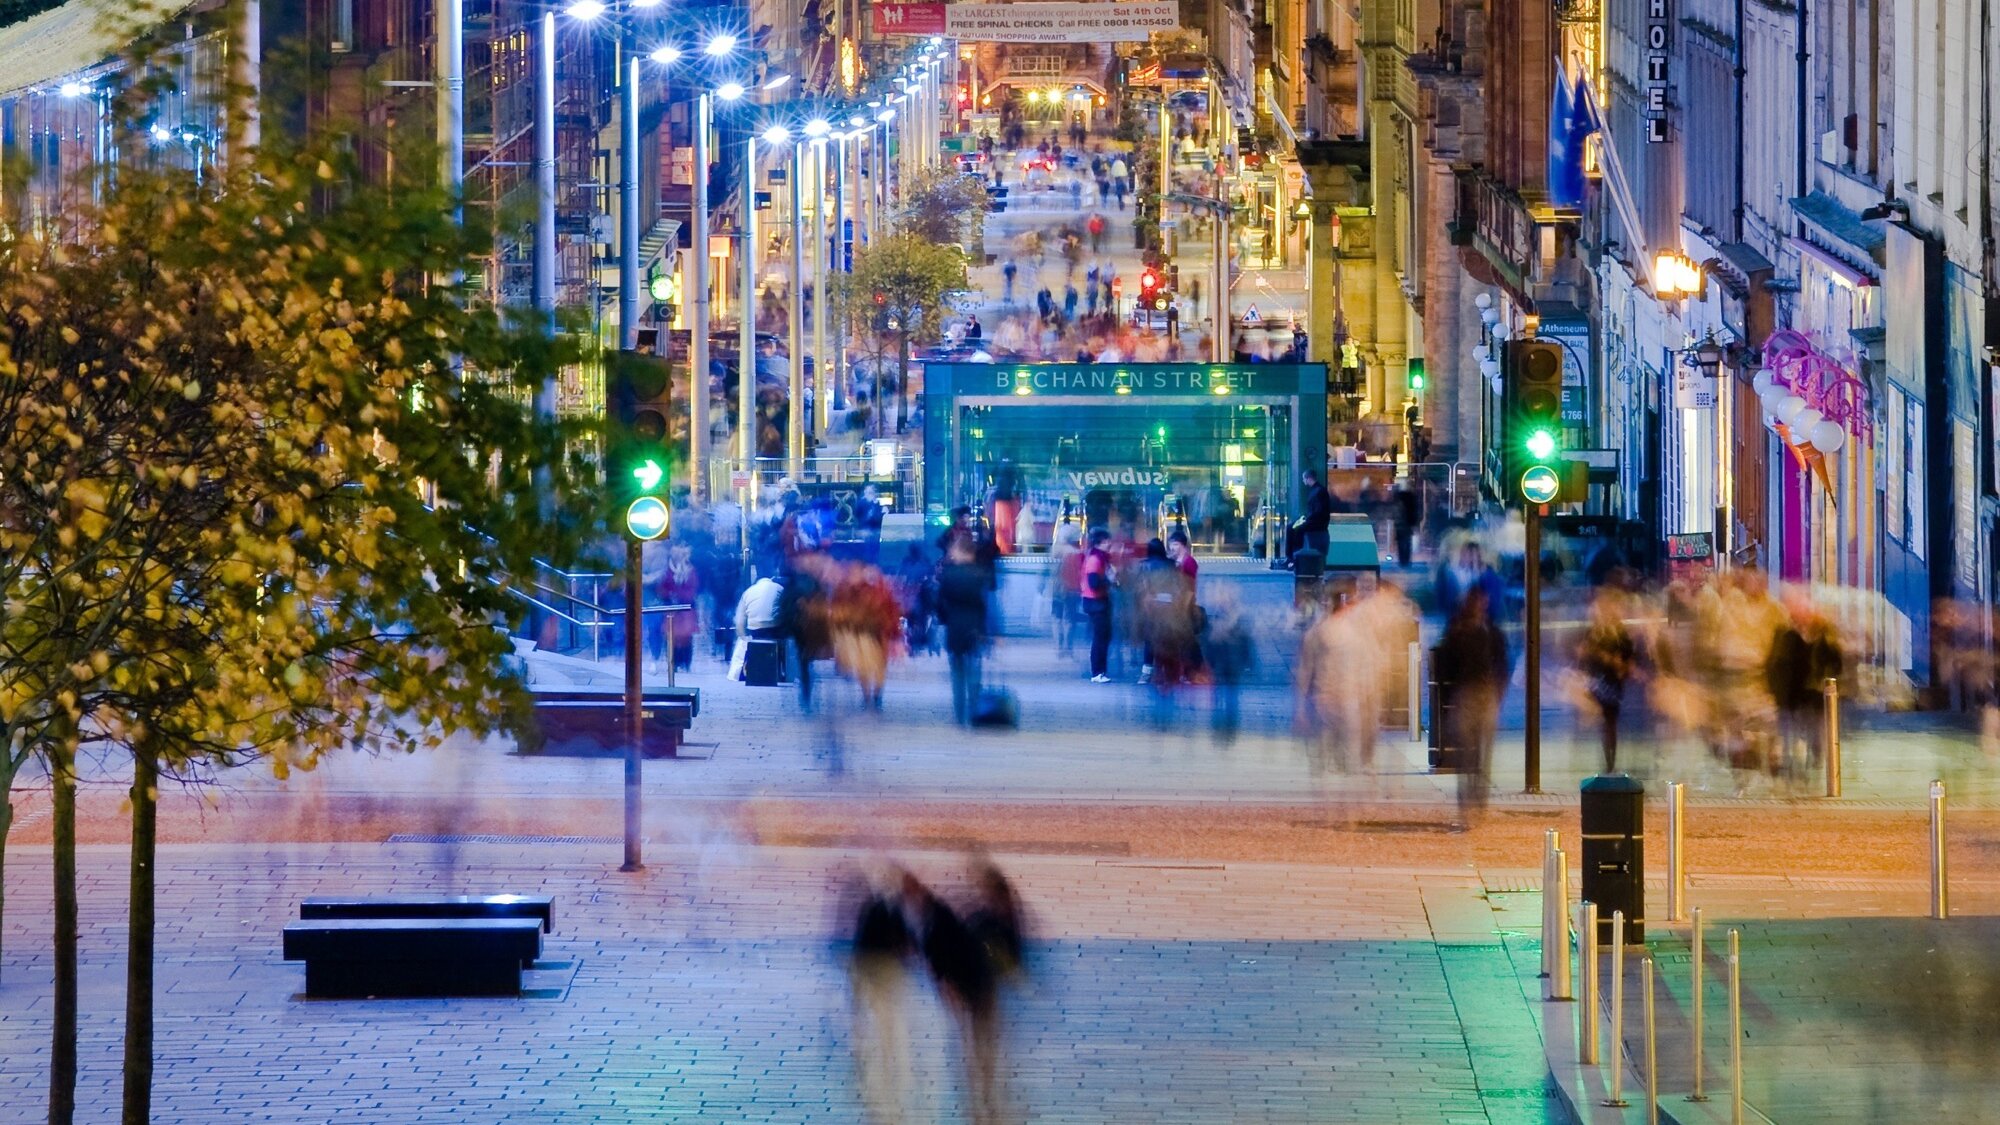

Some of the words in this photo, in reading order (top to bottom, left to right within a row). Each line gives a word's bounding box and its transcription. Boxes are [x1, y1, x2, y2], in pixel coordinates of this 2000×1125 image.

[965, 9, 1006, 18] LARGEST
[1008, 8, 1054, 19] chiropractic
[1056, 9, 1077, 18] open
[1078, 8, 1093, 18] day
[1113, 8, 1130, 16] Sat
[1134, 7, 1151, 15] 4th
[1154, 7, 1171, 15] Oct
[1013, 20, 1054, 28] CHECKS
[1103, 19, 1129, 27] 0808
[1132, 18, 1174, 26] 1435450
[1650, 0, 1665, 141] HOTEL
[1544, 324, 1588, 333] Atheneum
[996, 371, 1144, 388] BUCHANAN
[1153, 371, 1257, 388] STREET
